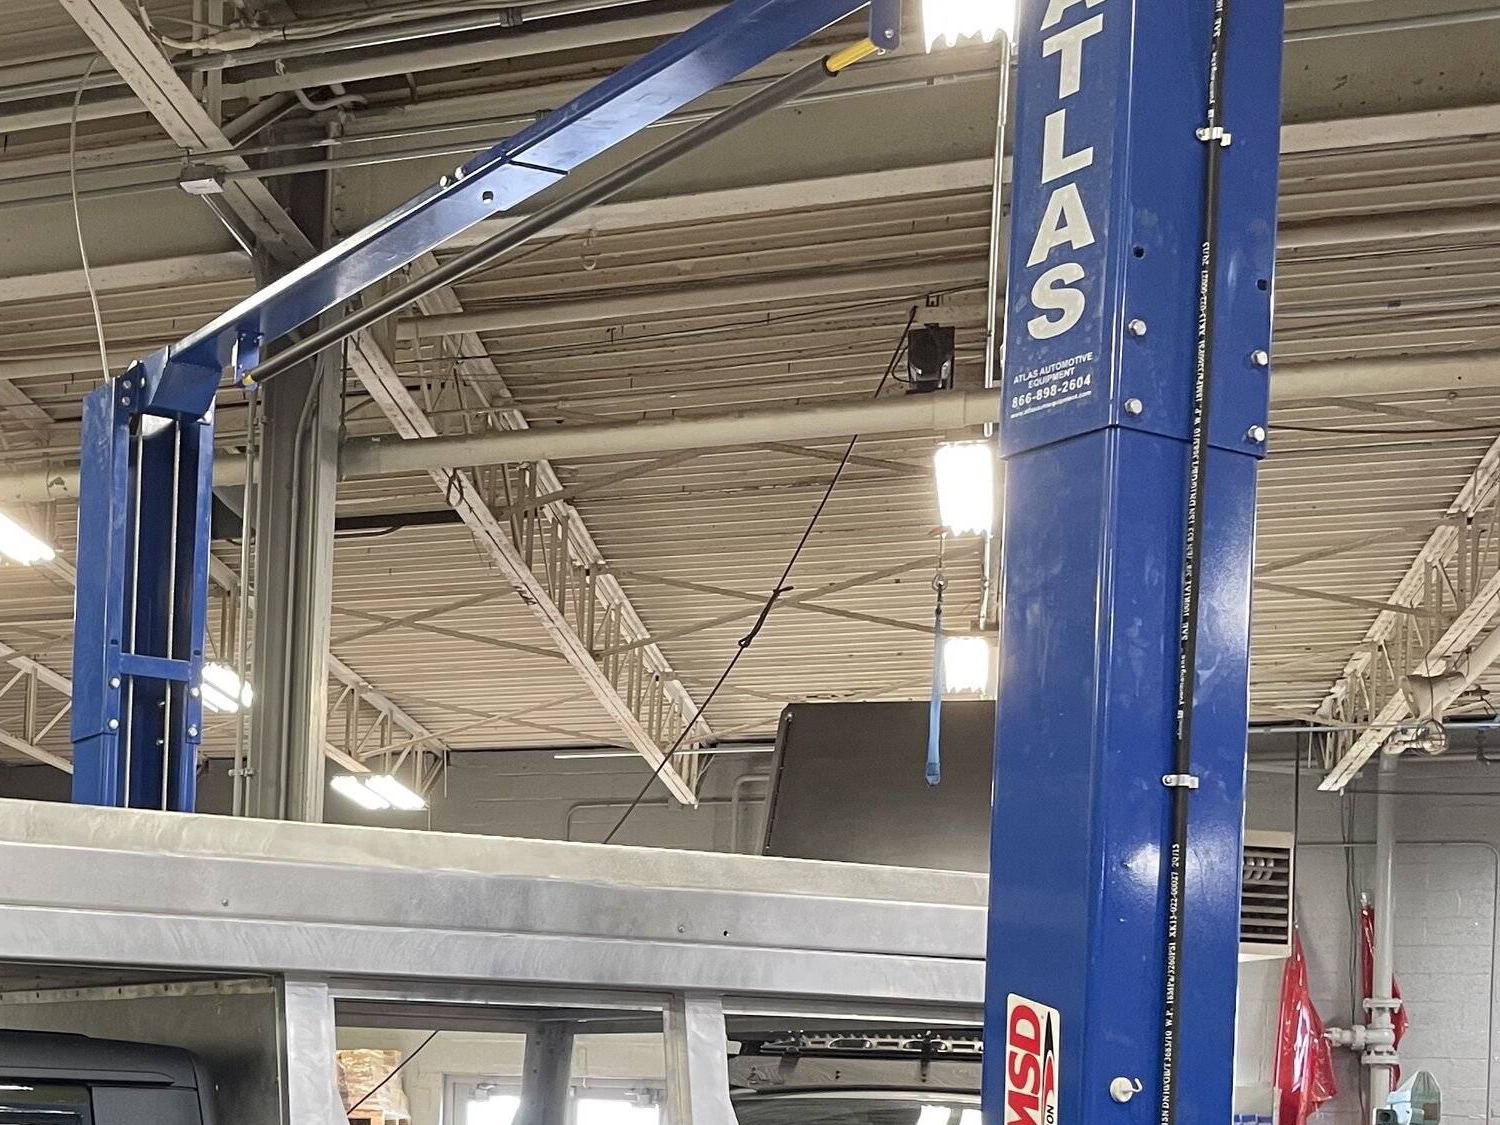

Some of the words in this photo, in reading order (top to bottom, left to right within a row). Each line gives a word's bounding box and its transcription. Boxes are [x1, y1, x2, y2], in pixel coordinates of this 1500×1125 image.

[1013, 369, 1039, 385] ATLAS
[1039, 351, 1094, 375] AUTOMOTIVE
[1028, 366, 1076, 389] EQUIPMENT
[1011, 373, 1092, 409] 866-898-2604
